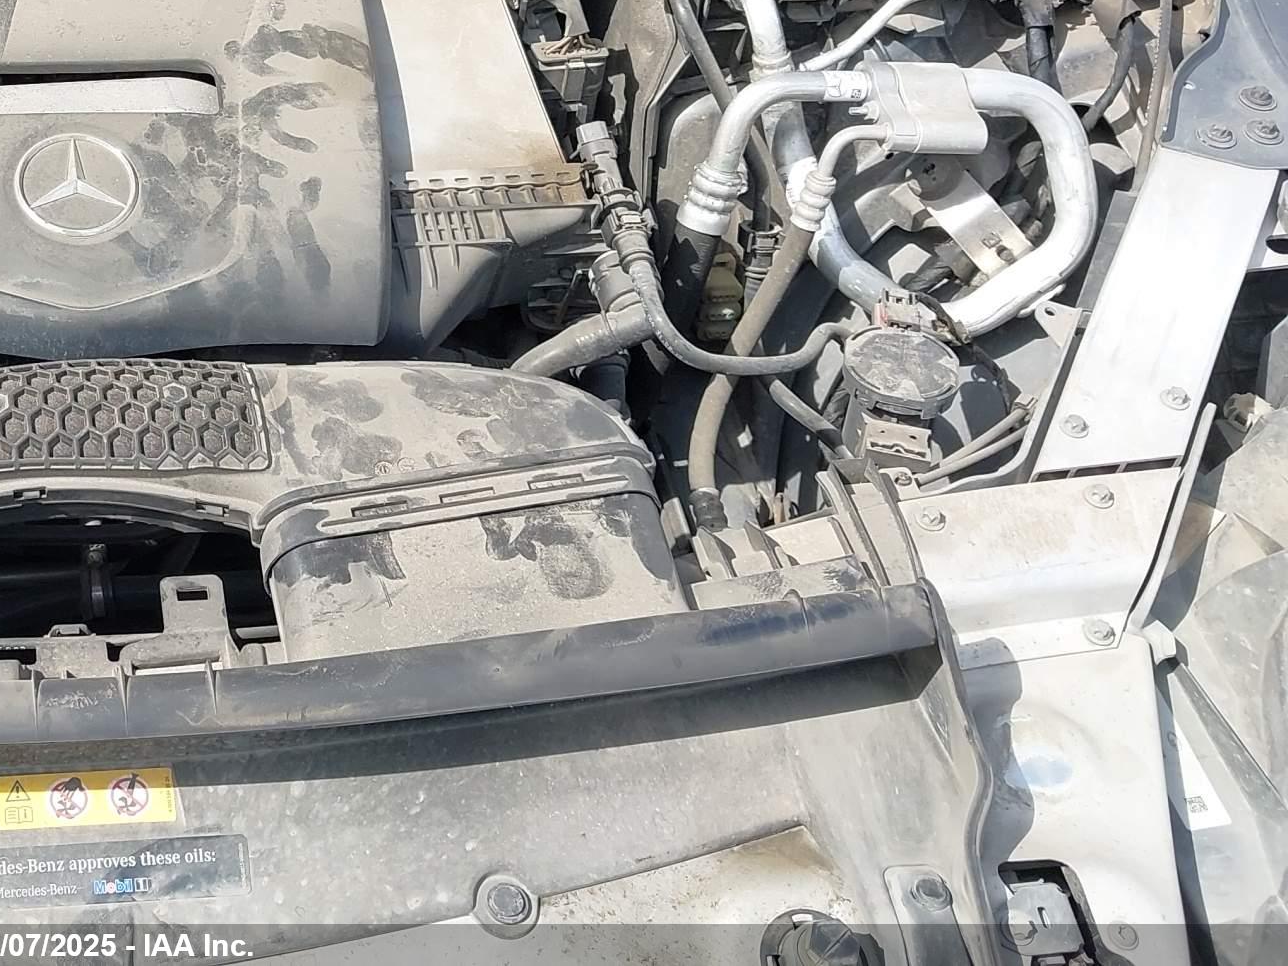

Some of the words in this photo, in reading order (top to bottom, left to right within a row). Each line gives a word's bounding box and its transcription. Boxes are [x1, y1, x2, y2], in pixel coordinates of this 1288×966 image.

[69, 854, 136, 873] approves
[140, 850, 181, 866] these
[184, 848, 216, 863] oils:
[93, 879, 132, 894] Mobil
